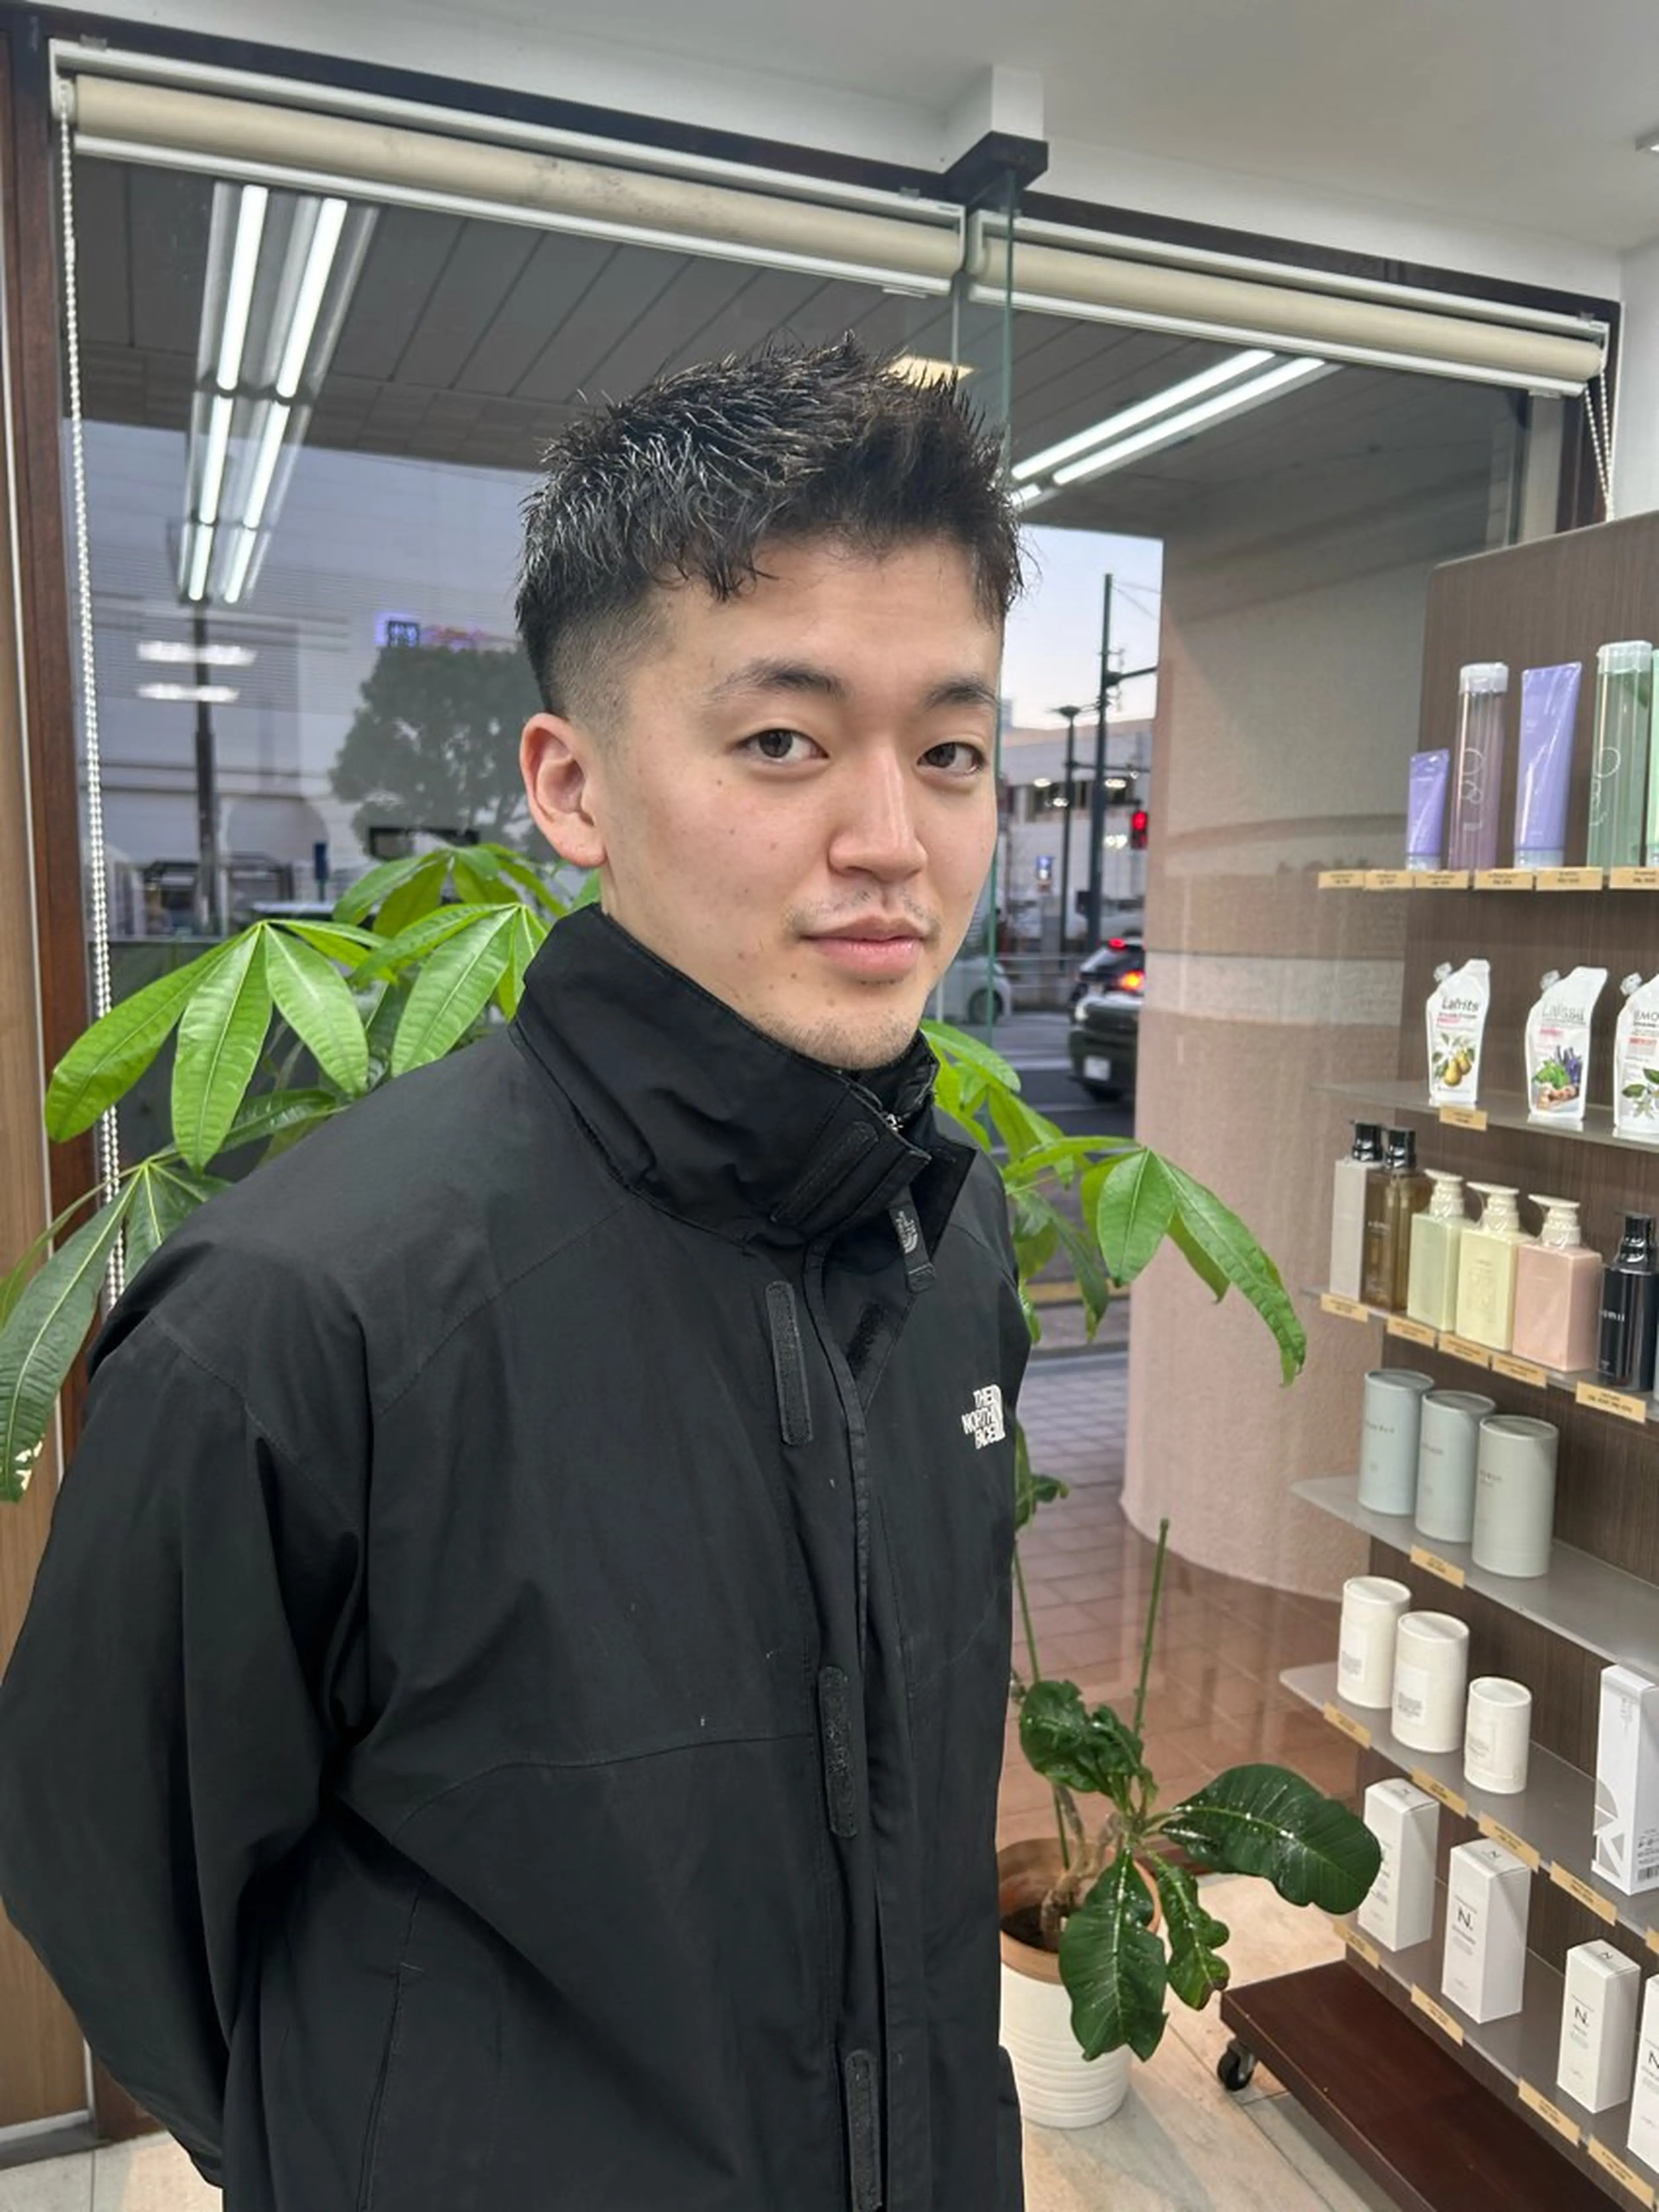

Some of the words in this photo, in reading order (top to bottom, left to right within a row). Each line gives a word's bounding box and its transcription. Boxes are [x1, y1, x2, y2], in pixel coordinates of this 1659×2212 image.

[973, 1387, 994, 1408] THE
[961, 1407, 995, 1434] NORTH
[975, 1425, 997, 1449] FACE
